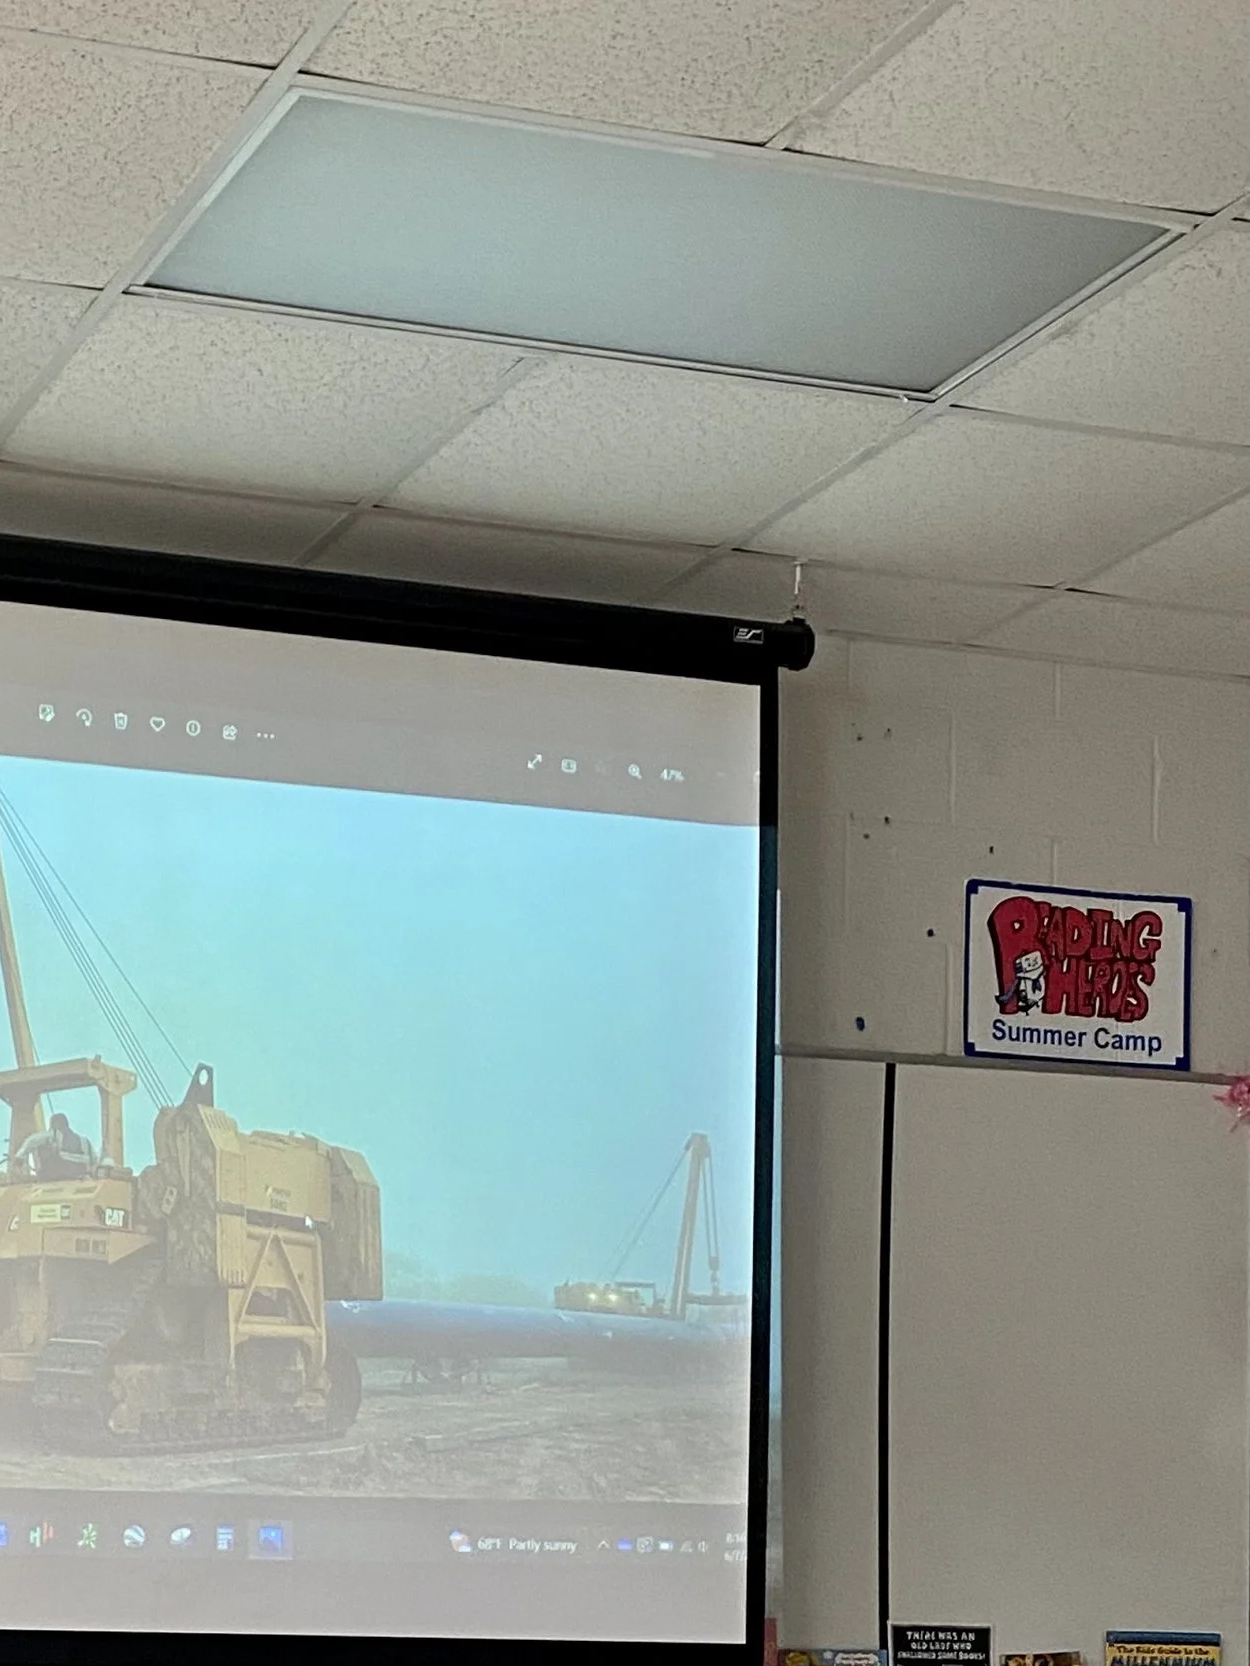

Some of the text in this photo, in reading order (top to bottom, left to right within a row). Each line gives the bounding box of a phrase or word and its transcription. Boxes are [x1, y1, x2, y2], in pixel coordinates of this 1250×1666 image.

[991, 1018, 1162, 1056] Summer Camp
[104, 1207, 125, 1227] CAT
[508, 1536, 541, 1554] Partly
[544, 1540, 578, 1556] sunny
[906, 1630, 976, 1641] THERE WAS AN
[910, 1641, 928, 1650] OLD
[952, 1642, 972, 1650] WHO
